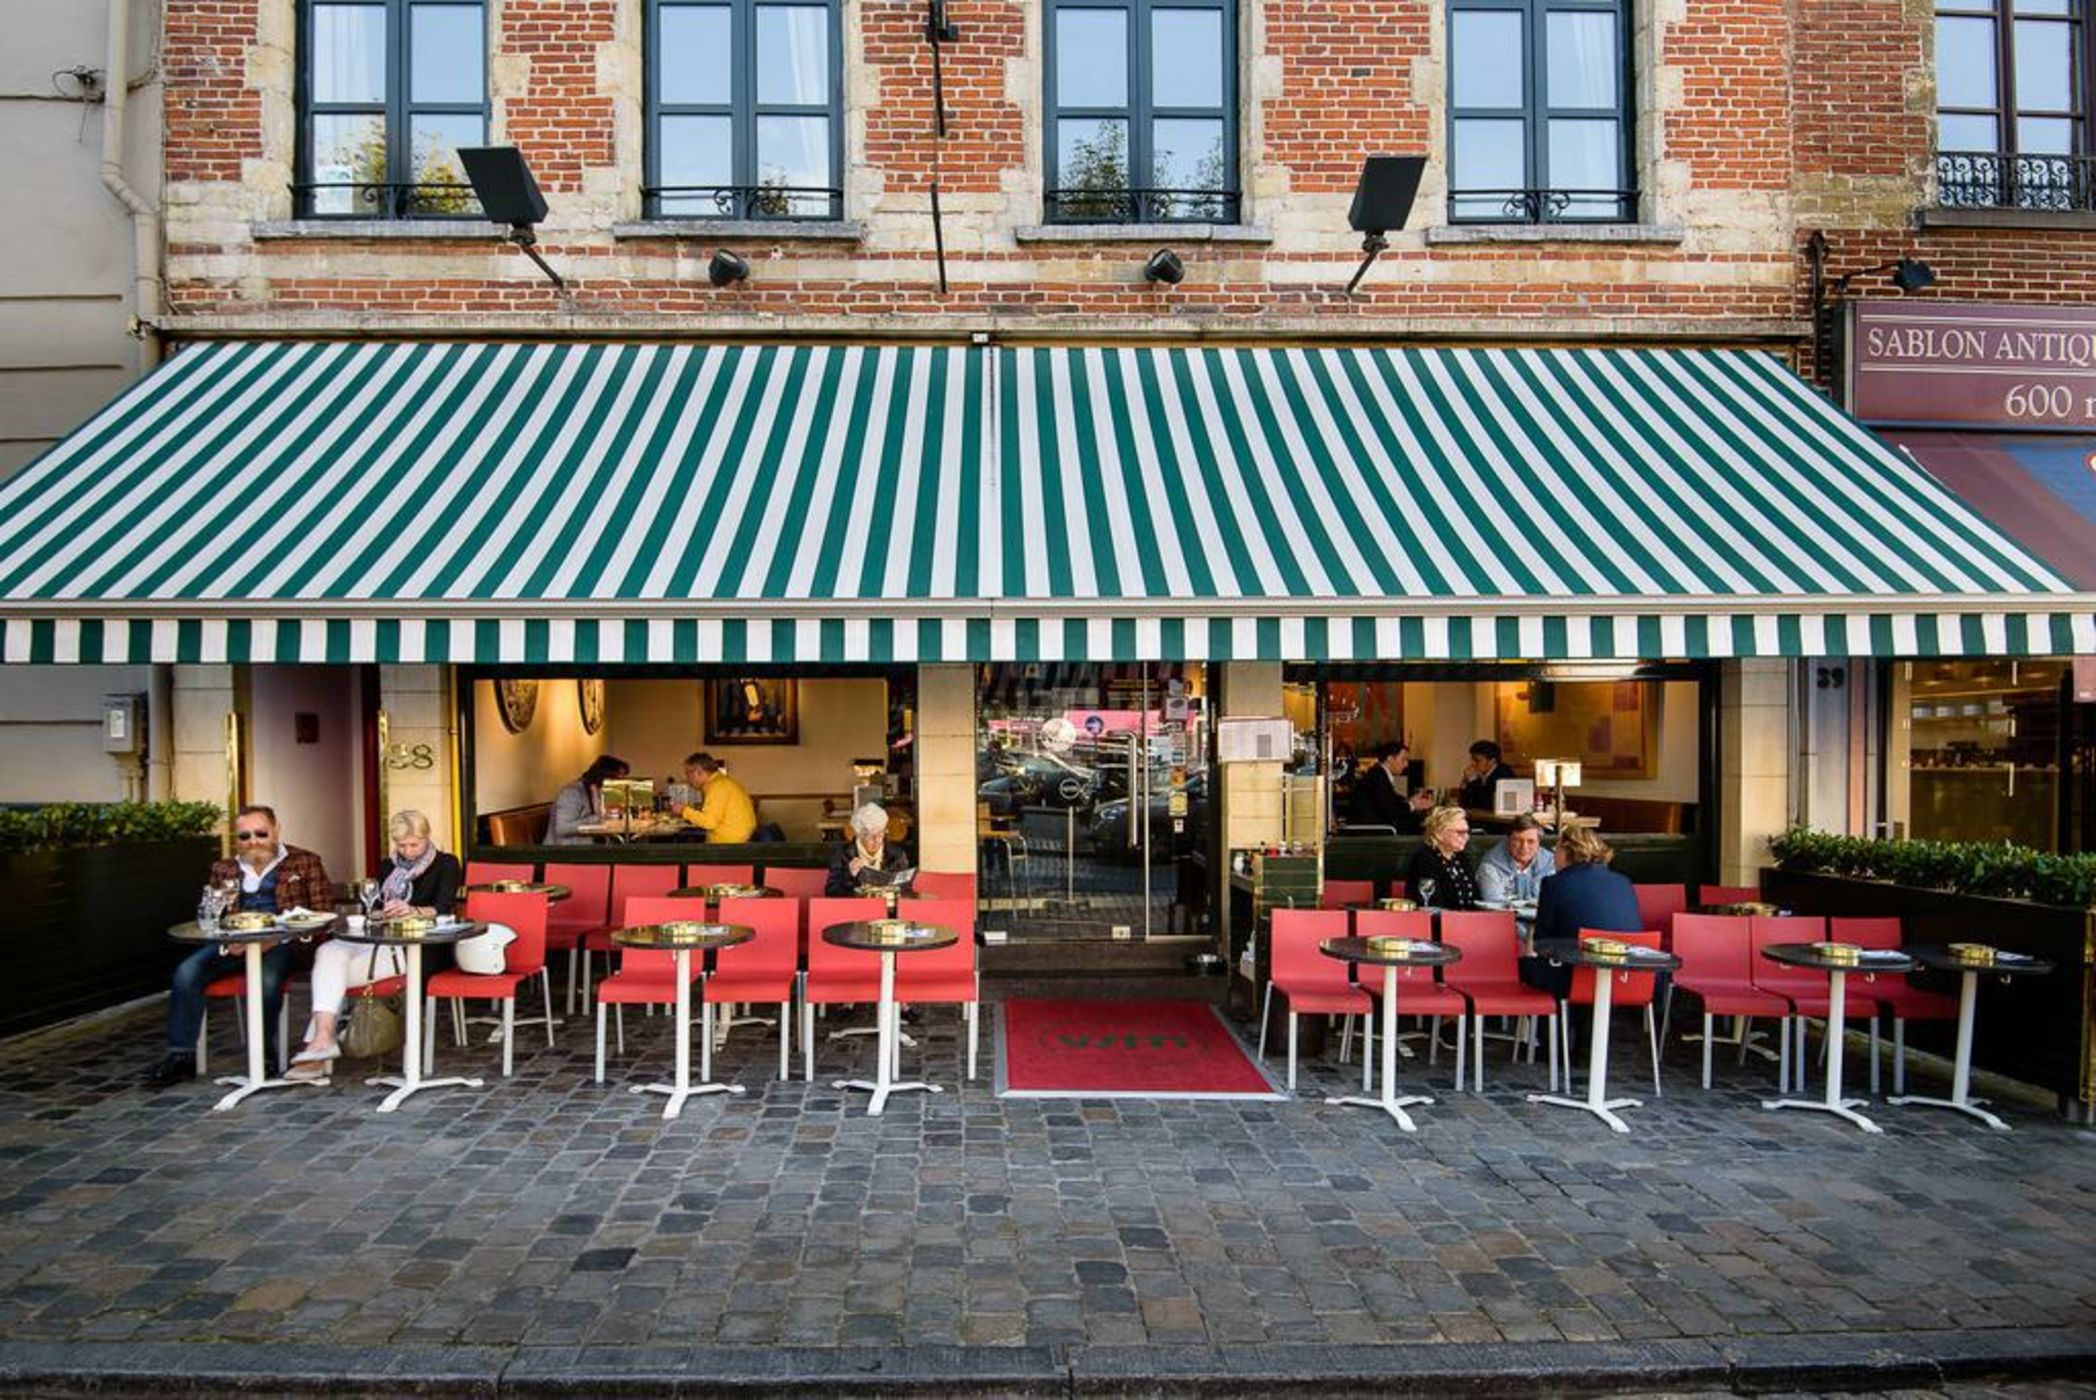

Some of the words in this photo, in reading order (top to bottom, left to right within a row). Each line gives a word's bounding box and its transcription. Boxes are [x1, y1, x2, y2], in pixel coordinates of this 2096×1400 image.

[1868, 327, 1987, 360] SABLON
[1994, 331, 2096, 367] ANTIQ
[2004, 384, 2073, 418] 600
[1816, 667, 1845, 689] 39
